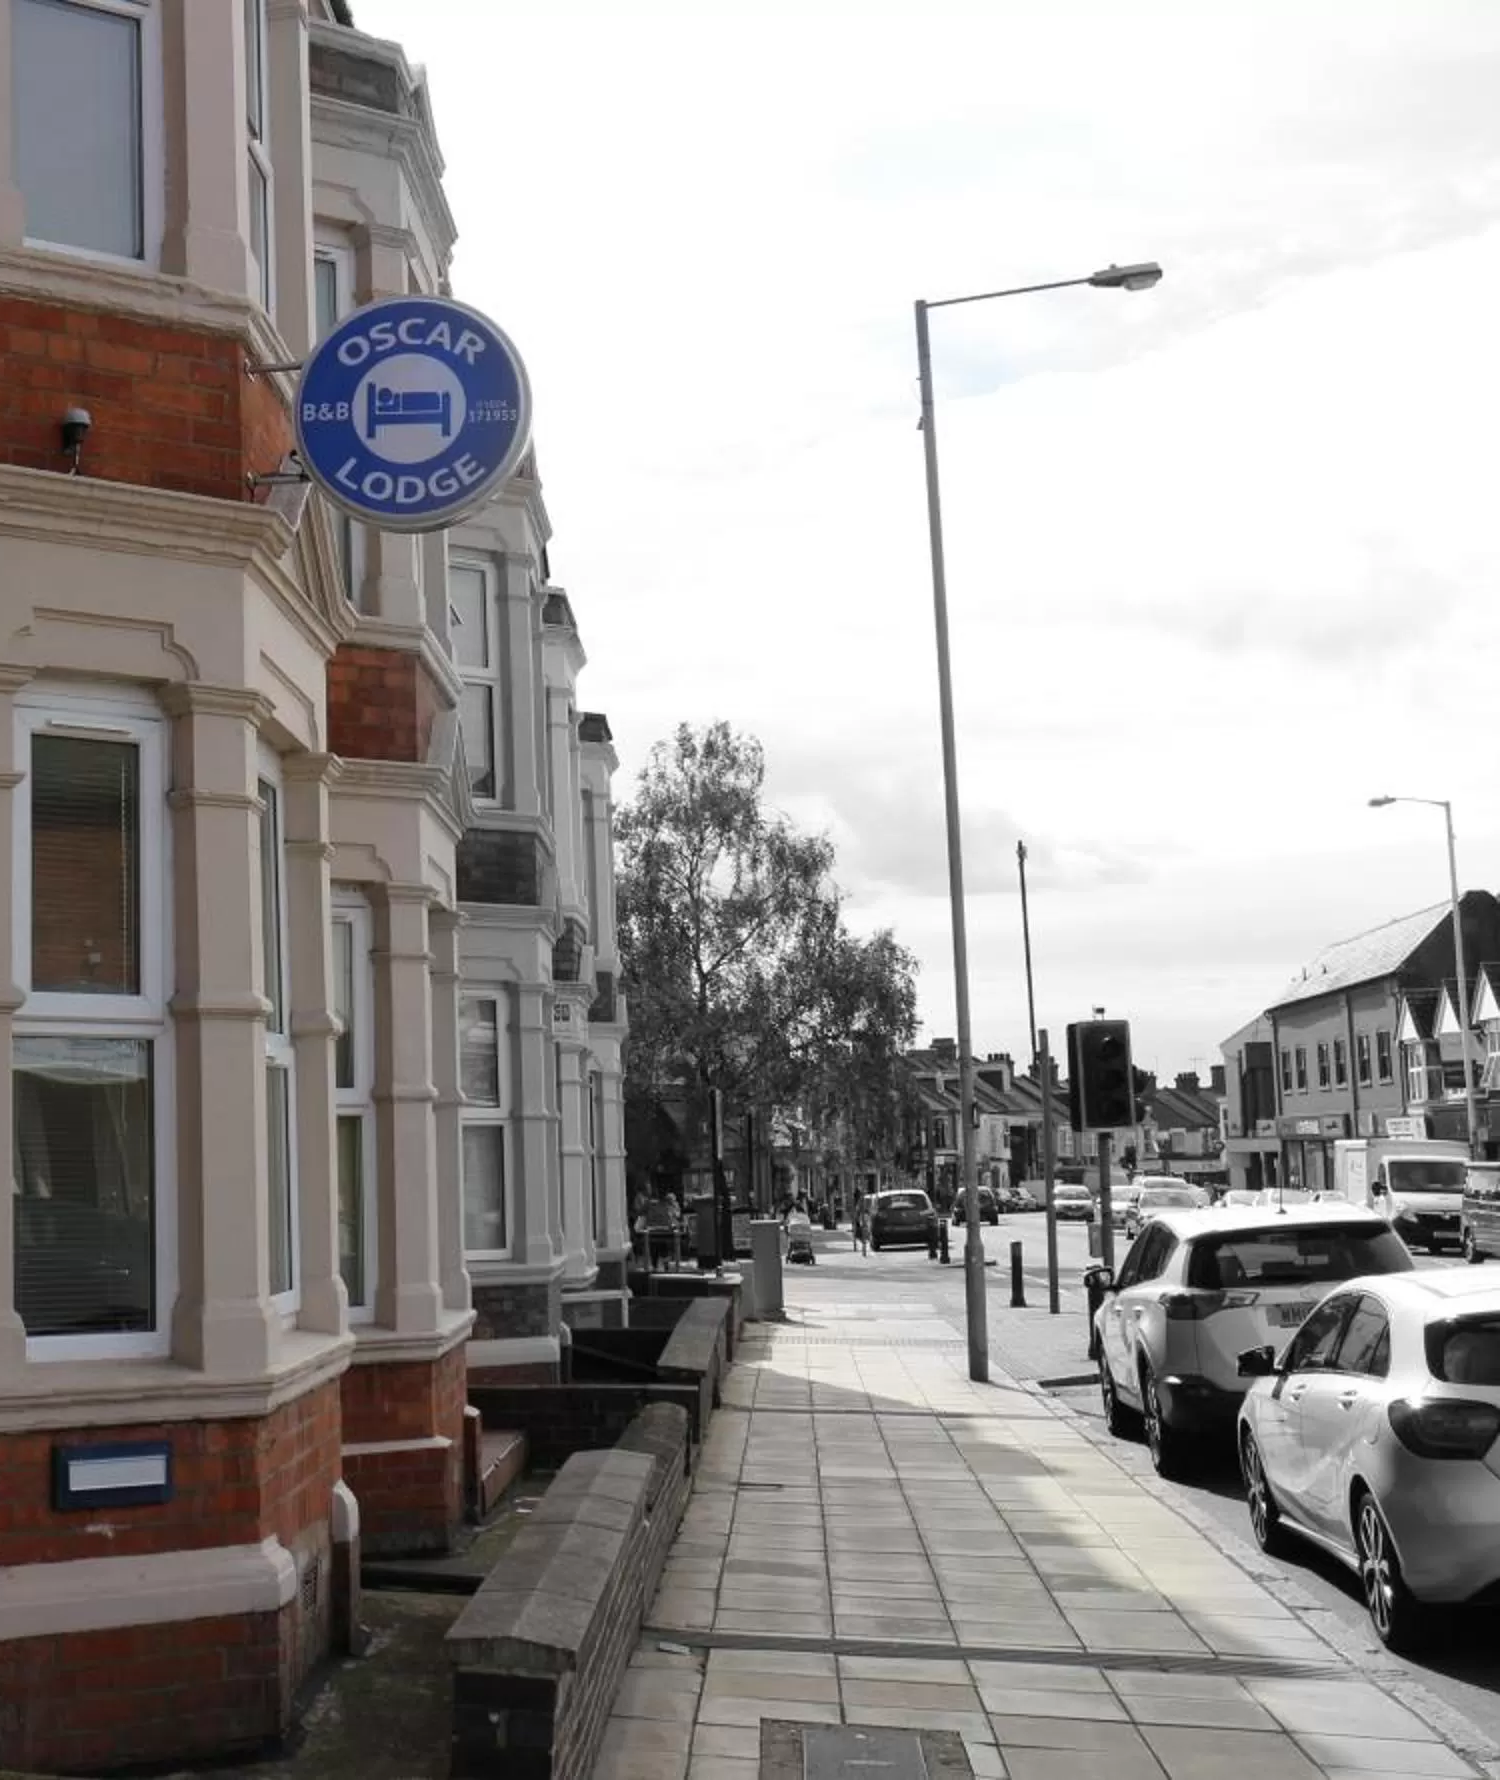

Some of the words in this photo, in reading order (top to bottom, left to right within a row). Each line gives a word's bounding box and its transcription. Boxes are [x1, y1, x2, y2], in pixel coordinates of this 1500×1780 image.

[336, 317, 487, 366] OSCAR
[302, 402, 350, 422] B&B
[334, 452, 486, 504] LODGE
